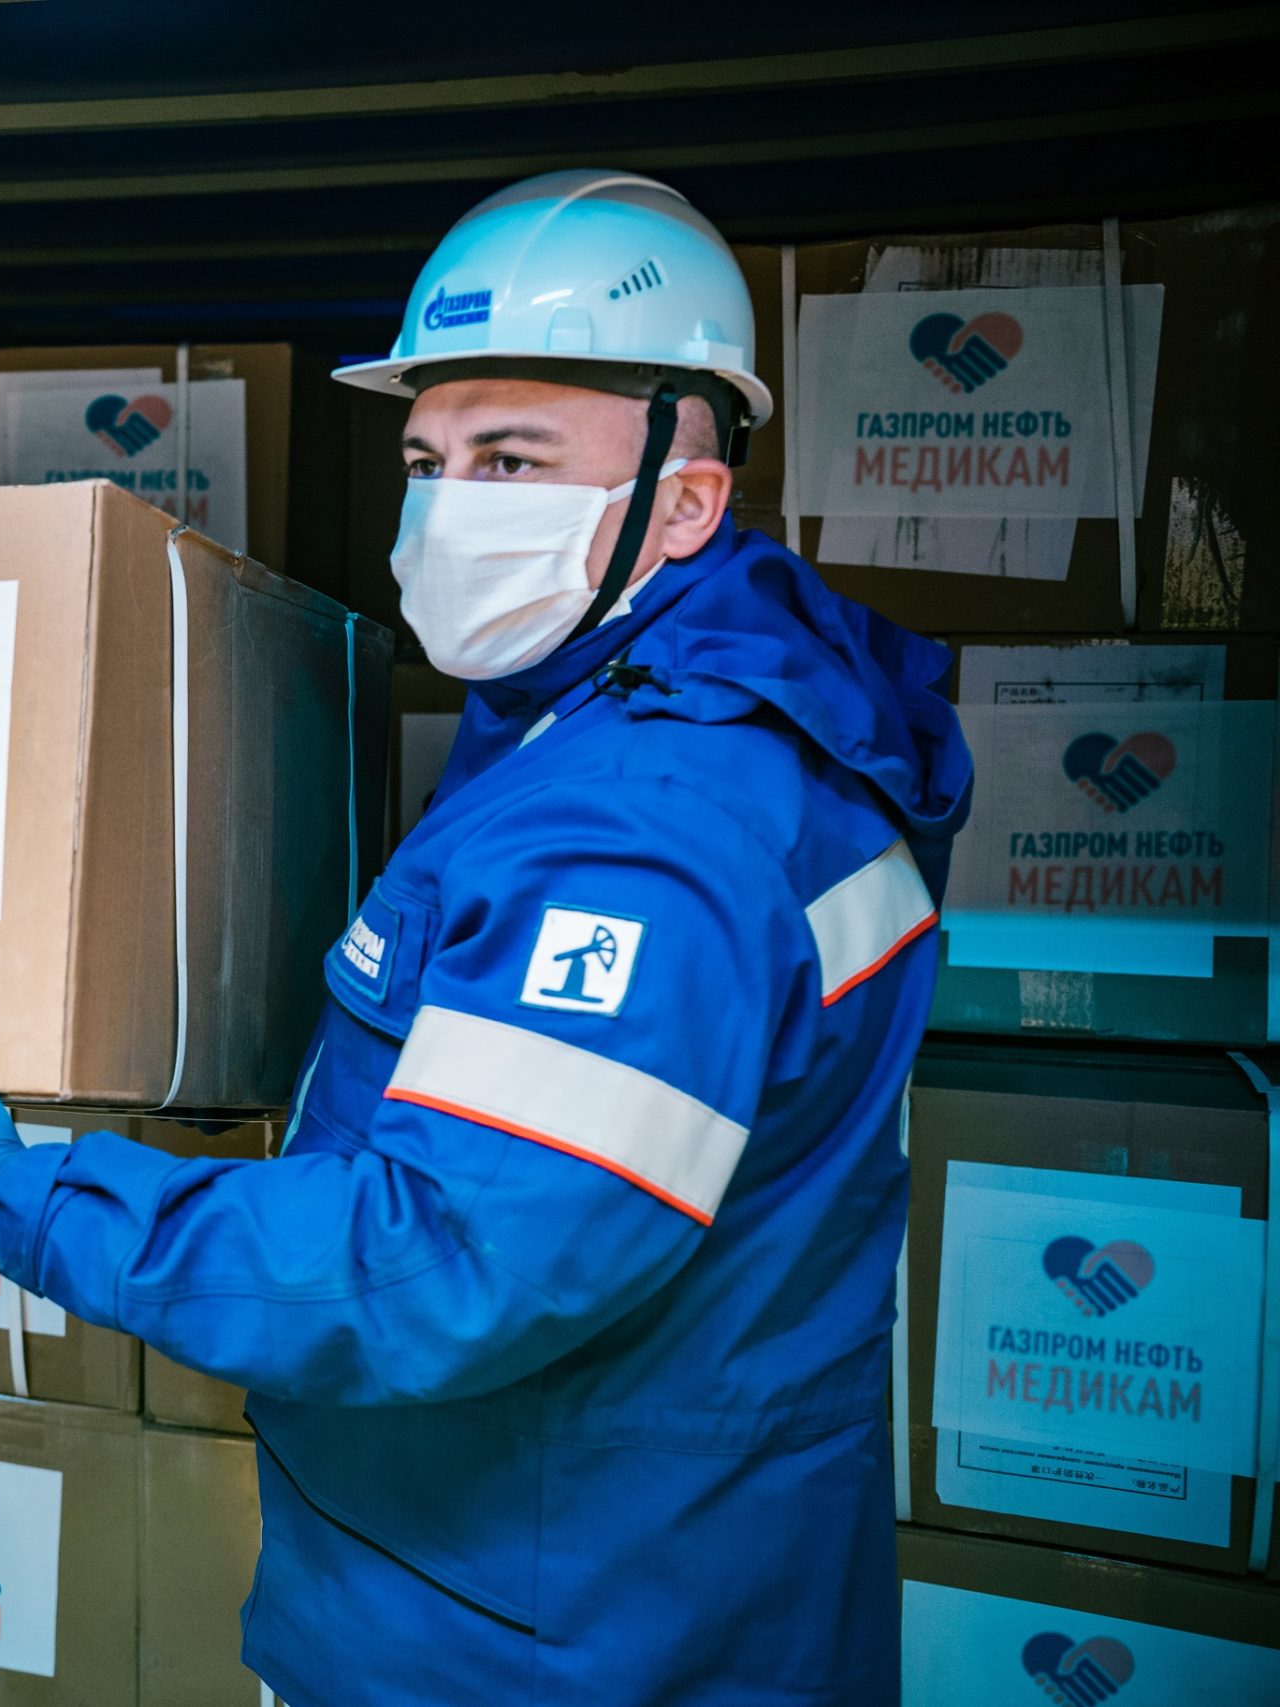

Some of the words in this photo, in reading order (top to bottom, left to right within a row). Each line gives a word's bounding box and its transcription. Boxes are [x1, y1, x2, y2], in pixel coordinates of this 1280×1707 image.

[856, 411, 974, 439] ГАЗПРОМ
[982, 410, 1072, 439] НЕФТЬ
[853, 445, 1070, 494] МЕДИКАМ
[1009, 832, 1127, 858] ГАЗПРОМ
[1135, 830, 1225, 859] НЕФТЬ
[1008, 864, 1225, 913] МЕДИКАМ
[988, 1325, 1107, 1363] ГАЗПРОМ
[1115, 1339, 1203, 1374] НЕФТЬ
[986, 1359, 1202, 1423] МЕДИКАМ
